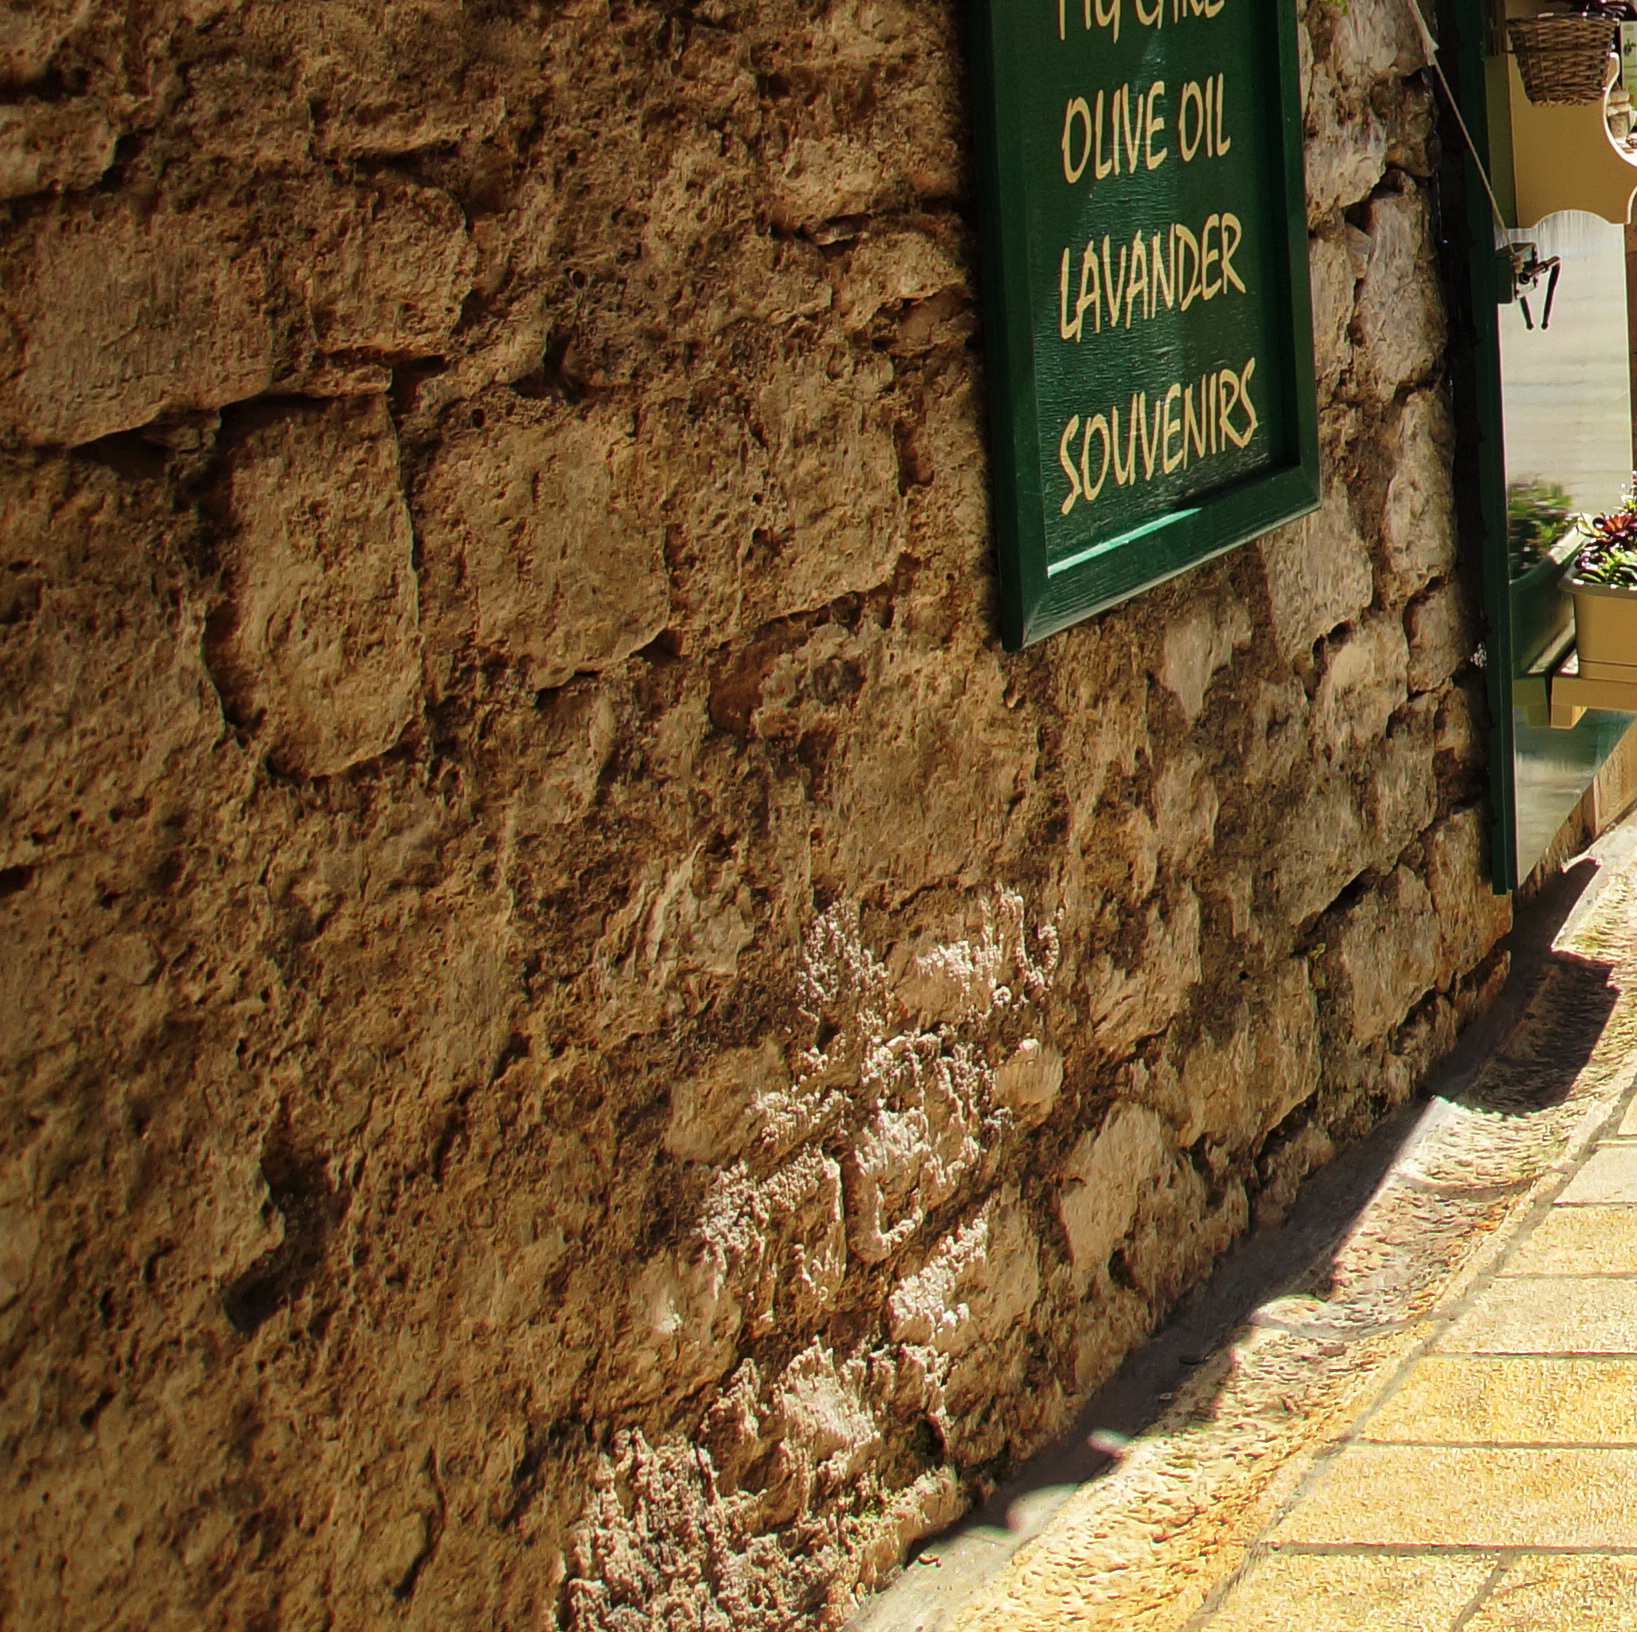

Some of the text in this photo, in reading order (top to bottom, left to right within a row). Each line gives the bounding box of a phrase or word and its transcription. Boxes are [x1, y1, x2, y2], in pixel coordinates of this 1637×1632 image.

[1061, 72, 1231, 184] OLIVE OIL
[1059, 212, 1247, 343] LAVANDER
[1058, 357, 1259, 516] SOUVENIRS
